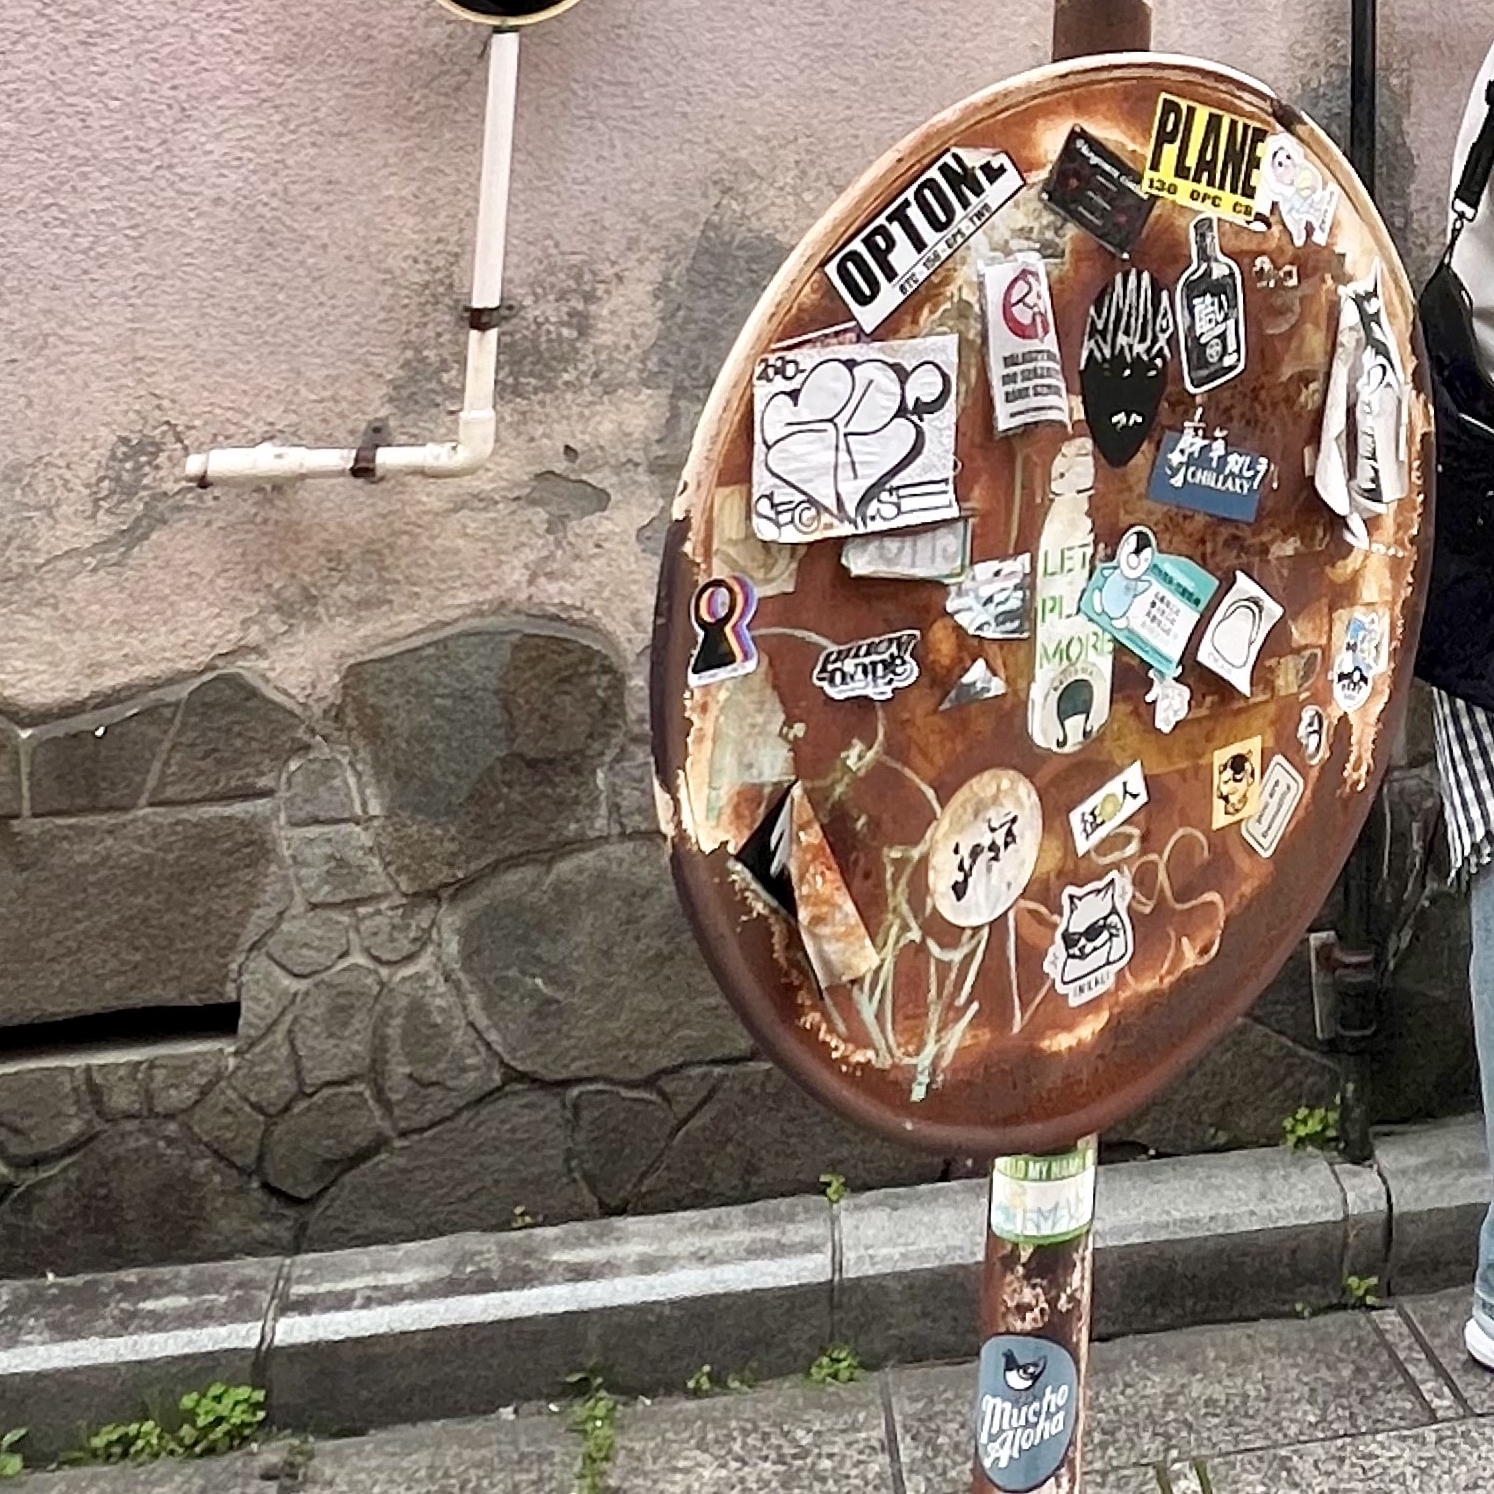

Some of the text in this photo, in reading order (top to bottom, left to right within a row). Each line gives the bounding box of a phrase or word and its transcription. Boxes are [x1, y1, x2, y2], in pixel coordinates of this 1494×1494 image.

[1149, 98, 1269, 200] PLANE
[1028, 1160, 1049, 1180] MY
[979, 1383, 1069, 1444] Mucho
[983, 1412, 1066, 1469] Aloha
